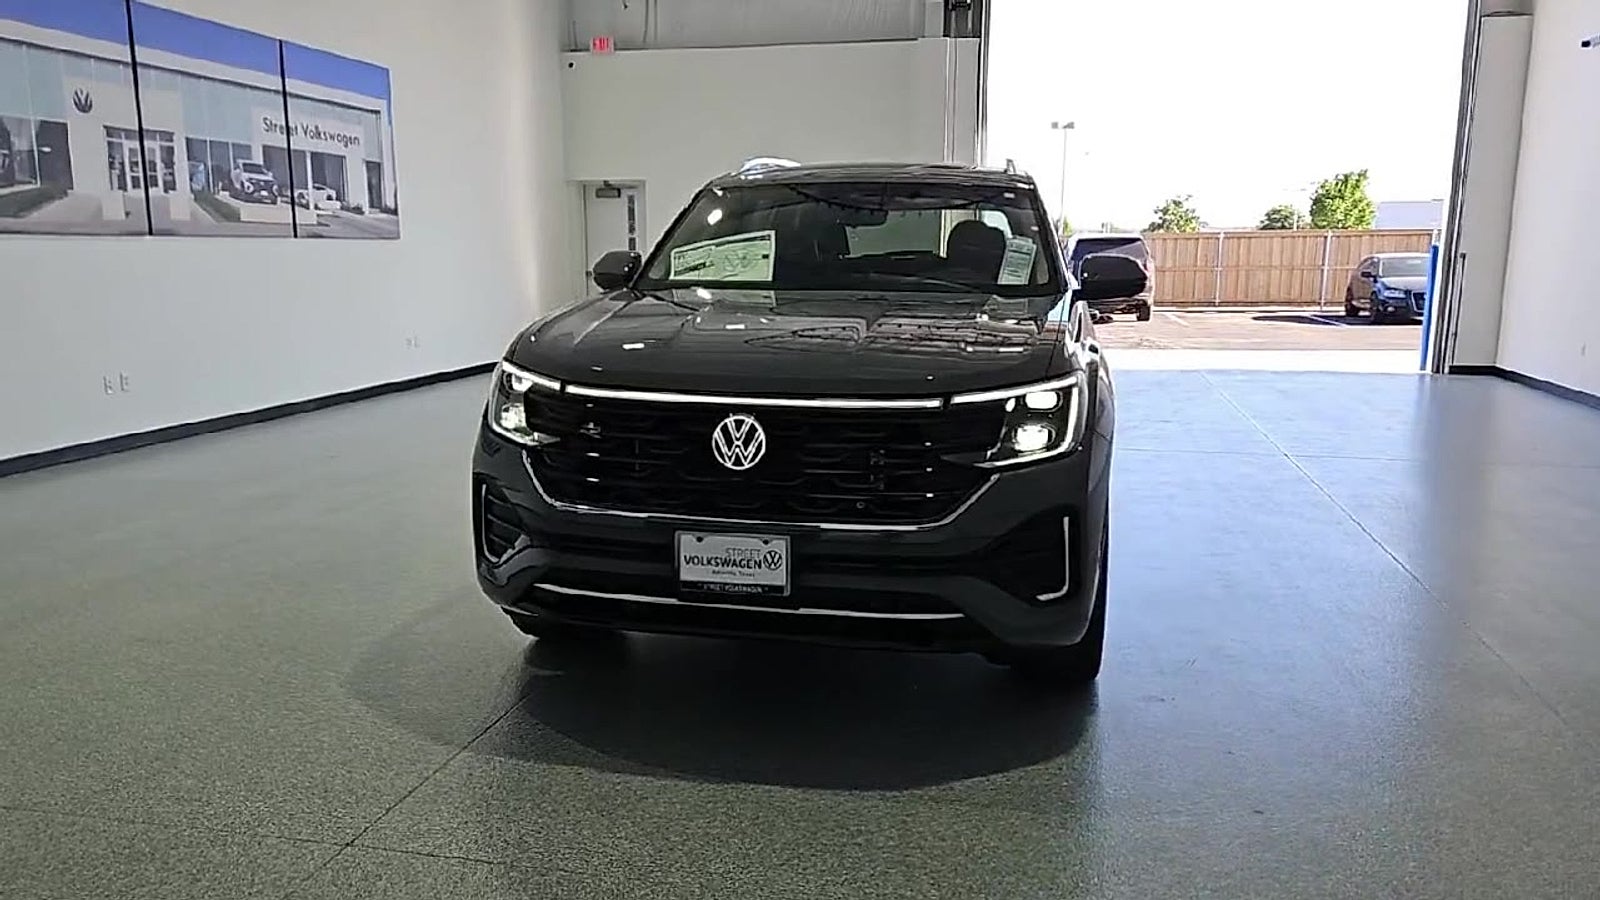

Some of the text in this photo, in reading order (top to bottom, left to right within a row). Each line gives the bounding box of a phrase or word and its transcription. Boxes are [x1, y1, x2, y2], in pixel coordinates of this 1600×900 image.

[262, 117, 360, 148] Street Volkswagen
[726, 547, 761, 559] STREET
[684, 555, 761, 569] VOLKSWAGEN
